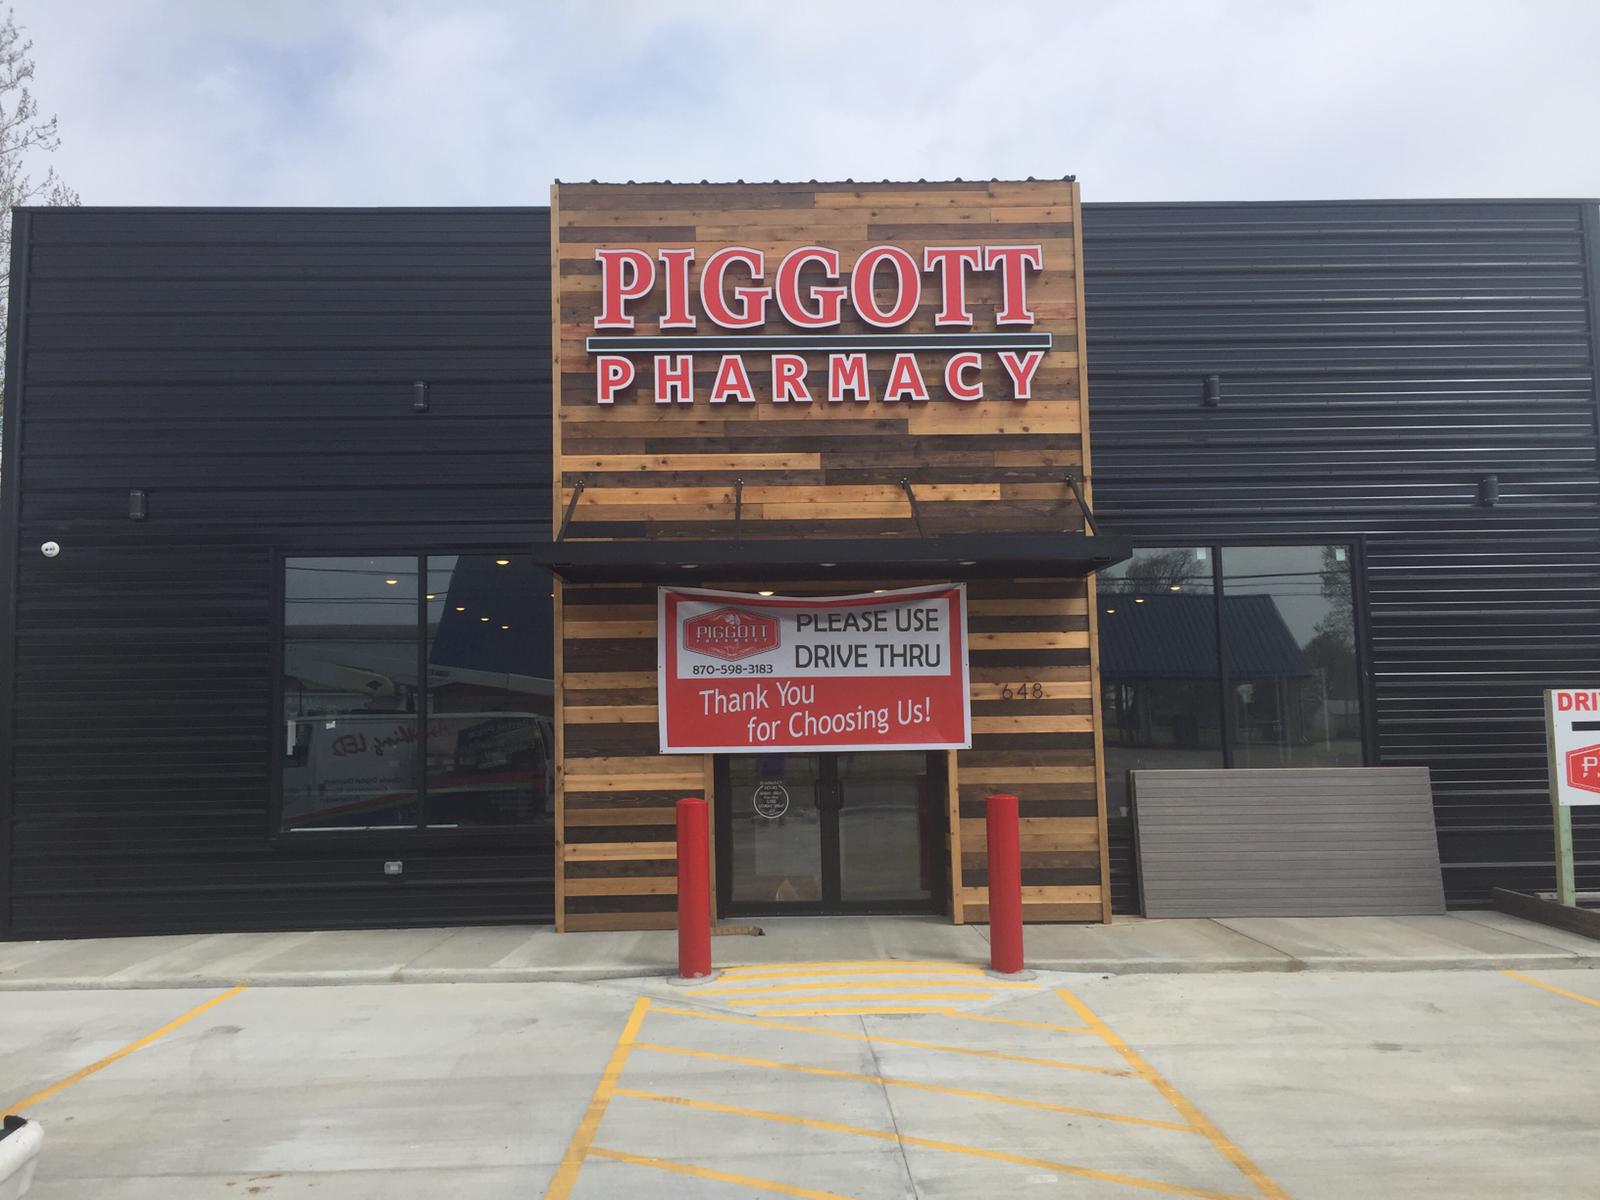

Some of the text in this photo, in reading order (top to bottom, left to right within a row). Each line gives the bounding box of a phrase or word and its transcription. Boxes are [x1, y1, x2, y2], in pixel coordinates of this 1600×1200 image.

[594, 245, 1044, 331] PIGGOTT
[596, 351, 1045, 404] PHARMACY
[696, 624, 768, 639] PIGGOTT
[796, 608, 939, 633] PLEASE USE
[795, 643, 941, 668] DRIVE THRU
[692, 664, 774, 675] 870-598-3183
[699, 681, 815, 716] Thank You
[1002, 682, 1043, 700] 648
[1557, 692, 1600, 711] DRI
[747, 696, 931, 743] for Choosing Us!
